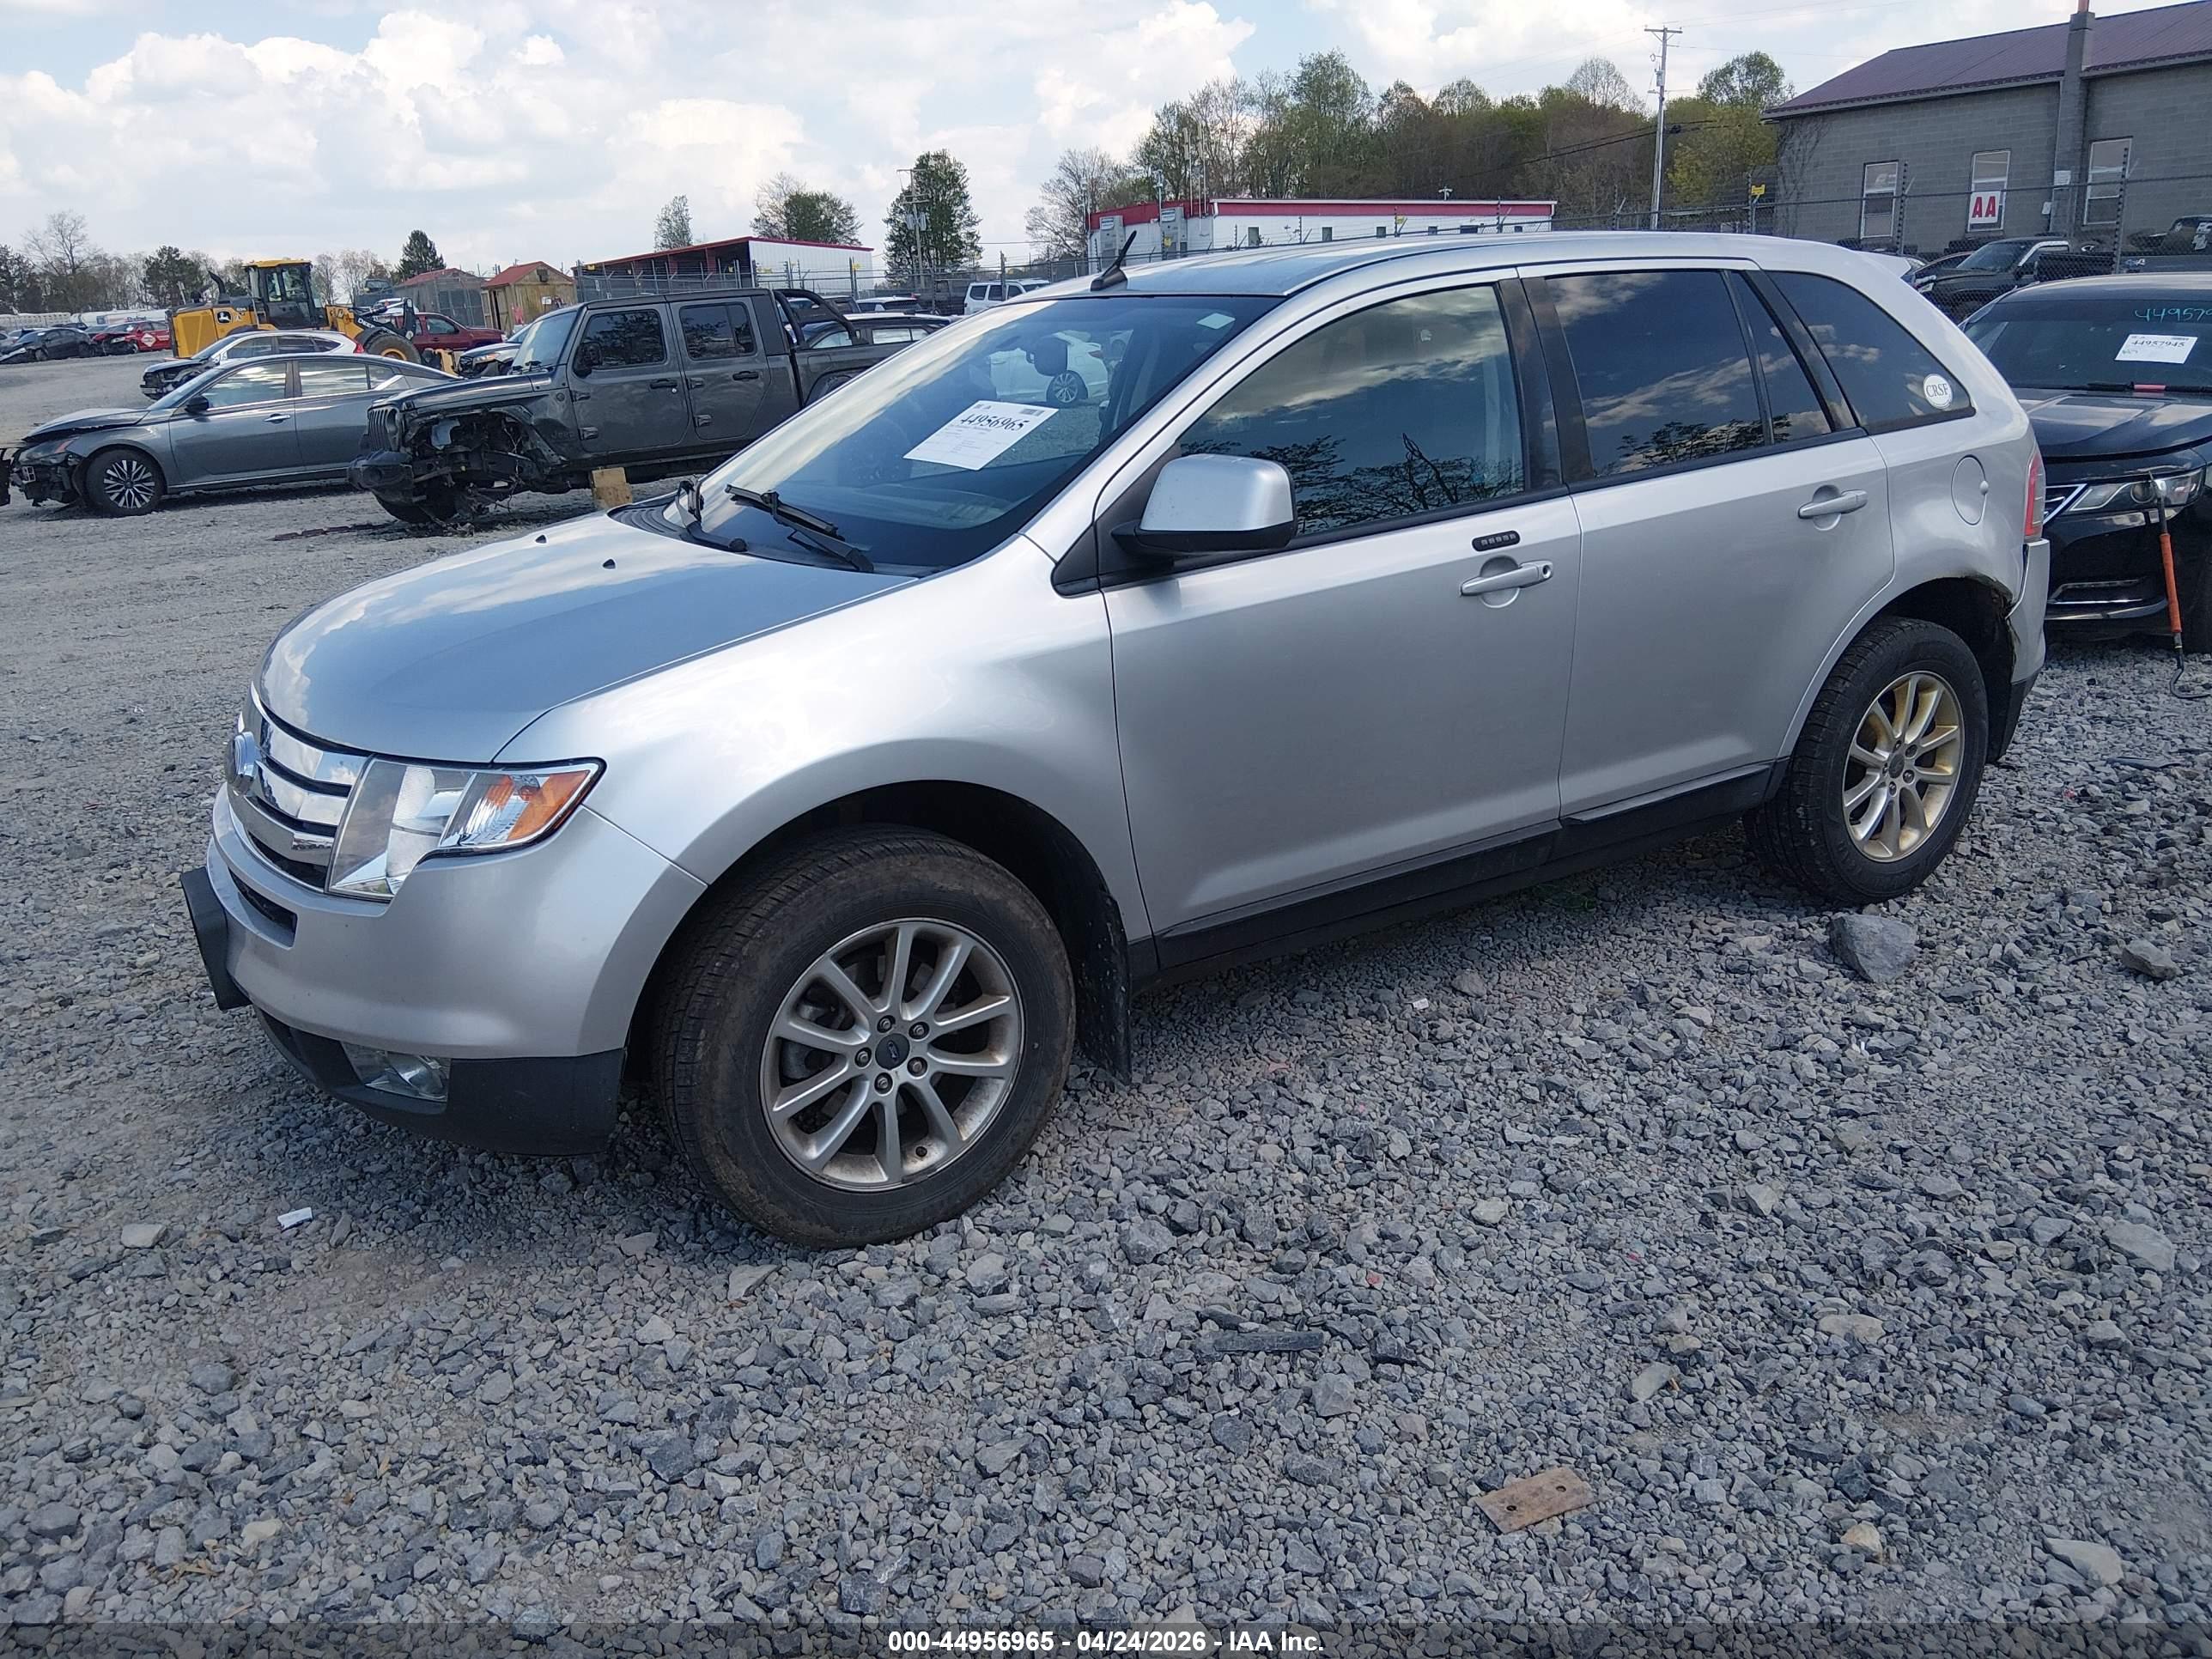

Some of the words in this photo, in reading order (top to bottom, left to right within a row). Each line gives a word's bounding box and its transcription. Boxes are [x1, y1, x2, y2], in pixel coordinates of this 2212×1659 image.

[1972, 196, 1996, 218] AA
[1926, 383, 1948, 398] CRSF
[961, 414, 1030, 431] 44956965
